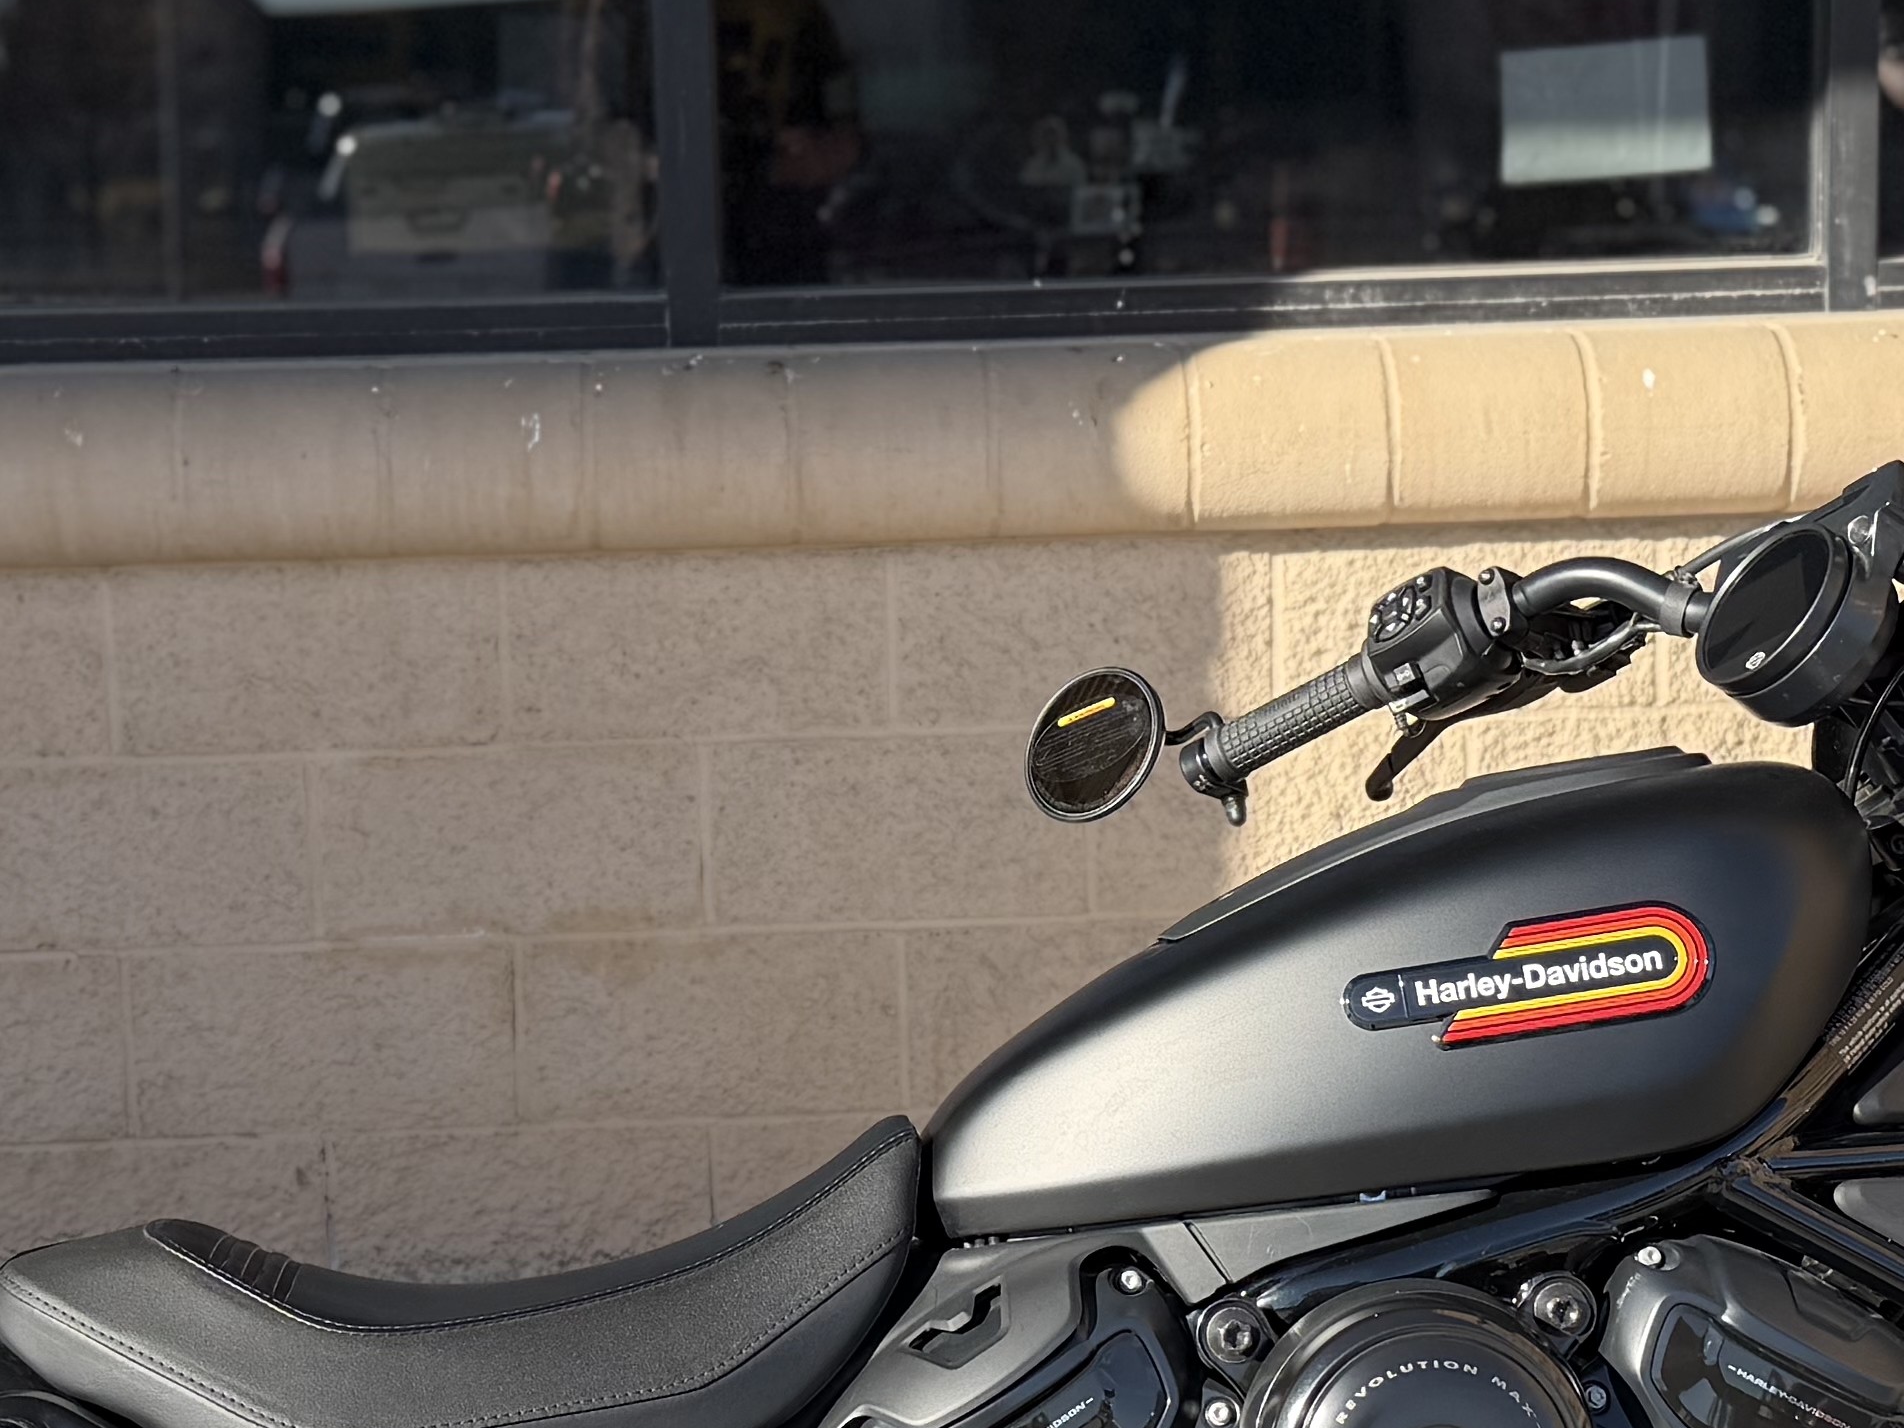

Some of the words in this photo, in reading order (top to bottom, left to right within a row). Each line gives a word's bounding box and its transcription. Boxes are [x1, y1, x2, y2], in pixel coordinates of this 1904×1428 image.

[1415, 949, 1663, 1009] Harley-Davidson
[1335, 1359, 1478, 1425] REVOLUTION
[1491, 1376, 1534, 1417] MAX
